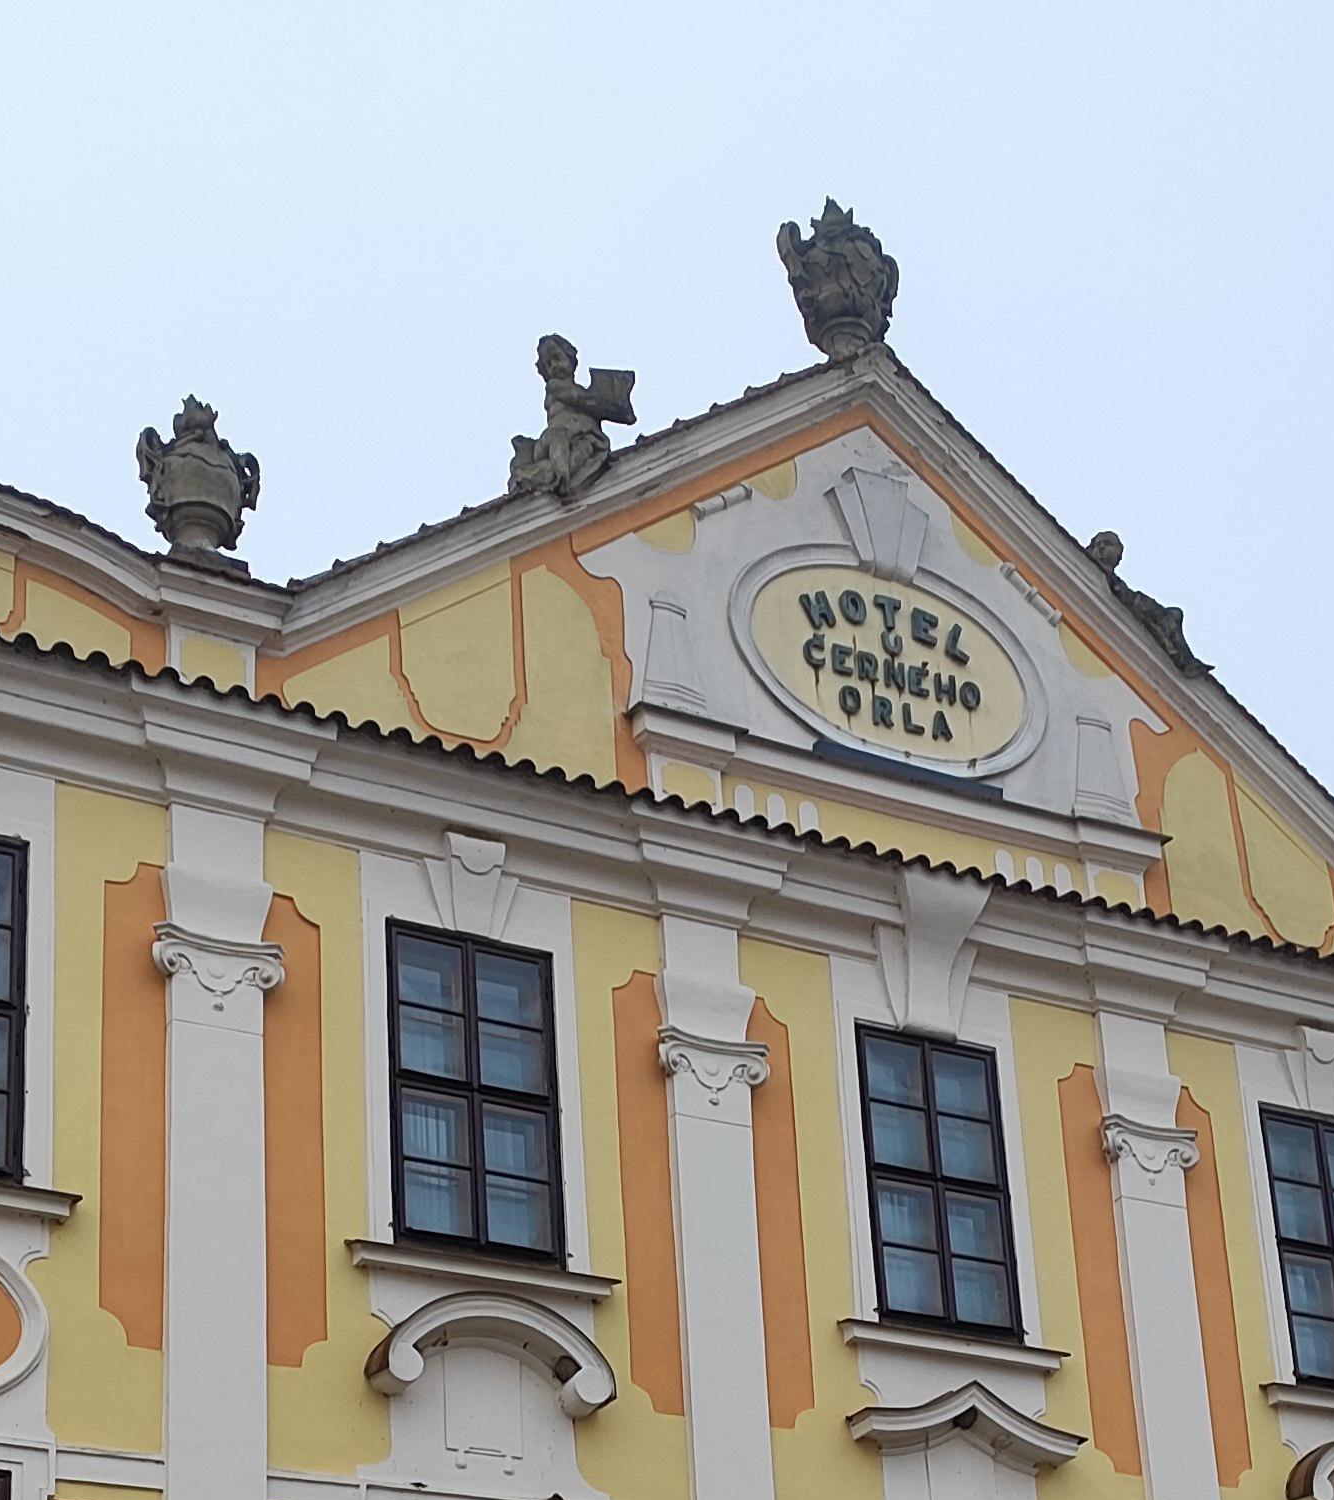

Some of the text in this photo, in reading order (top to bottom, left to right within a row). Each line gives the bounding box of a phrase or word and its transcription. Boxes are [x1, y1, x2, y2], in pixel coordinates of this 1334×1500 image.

[799, 590, 970, 665] HOTEL
[881, 631, 903, 657] U
[803, 632, 981, 711] ČERNÉHO
[839, 685, 953, 742] ORLA
